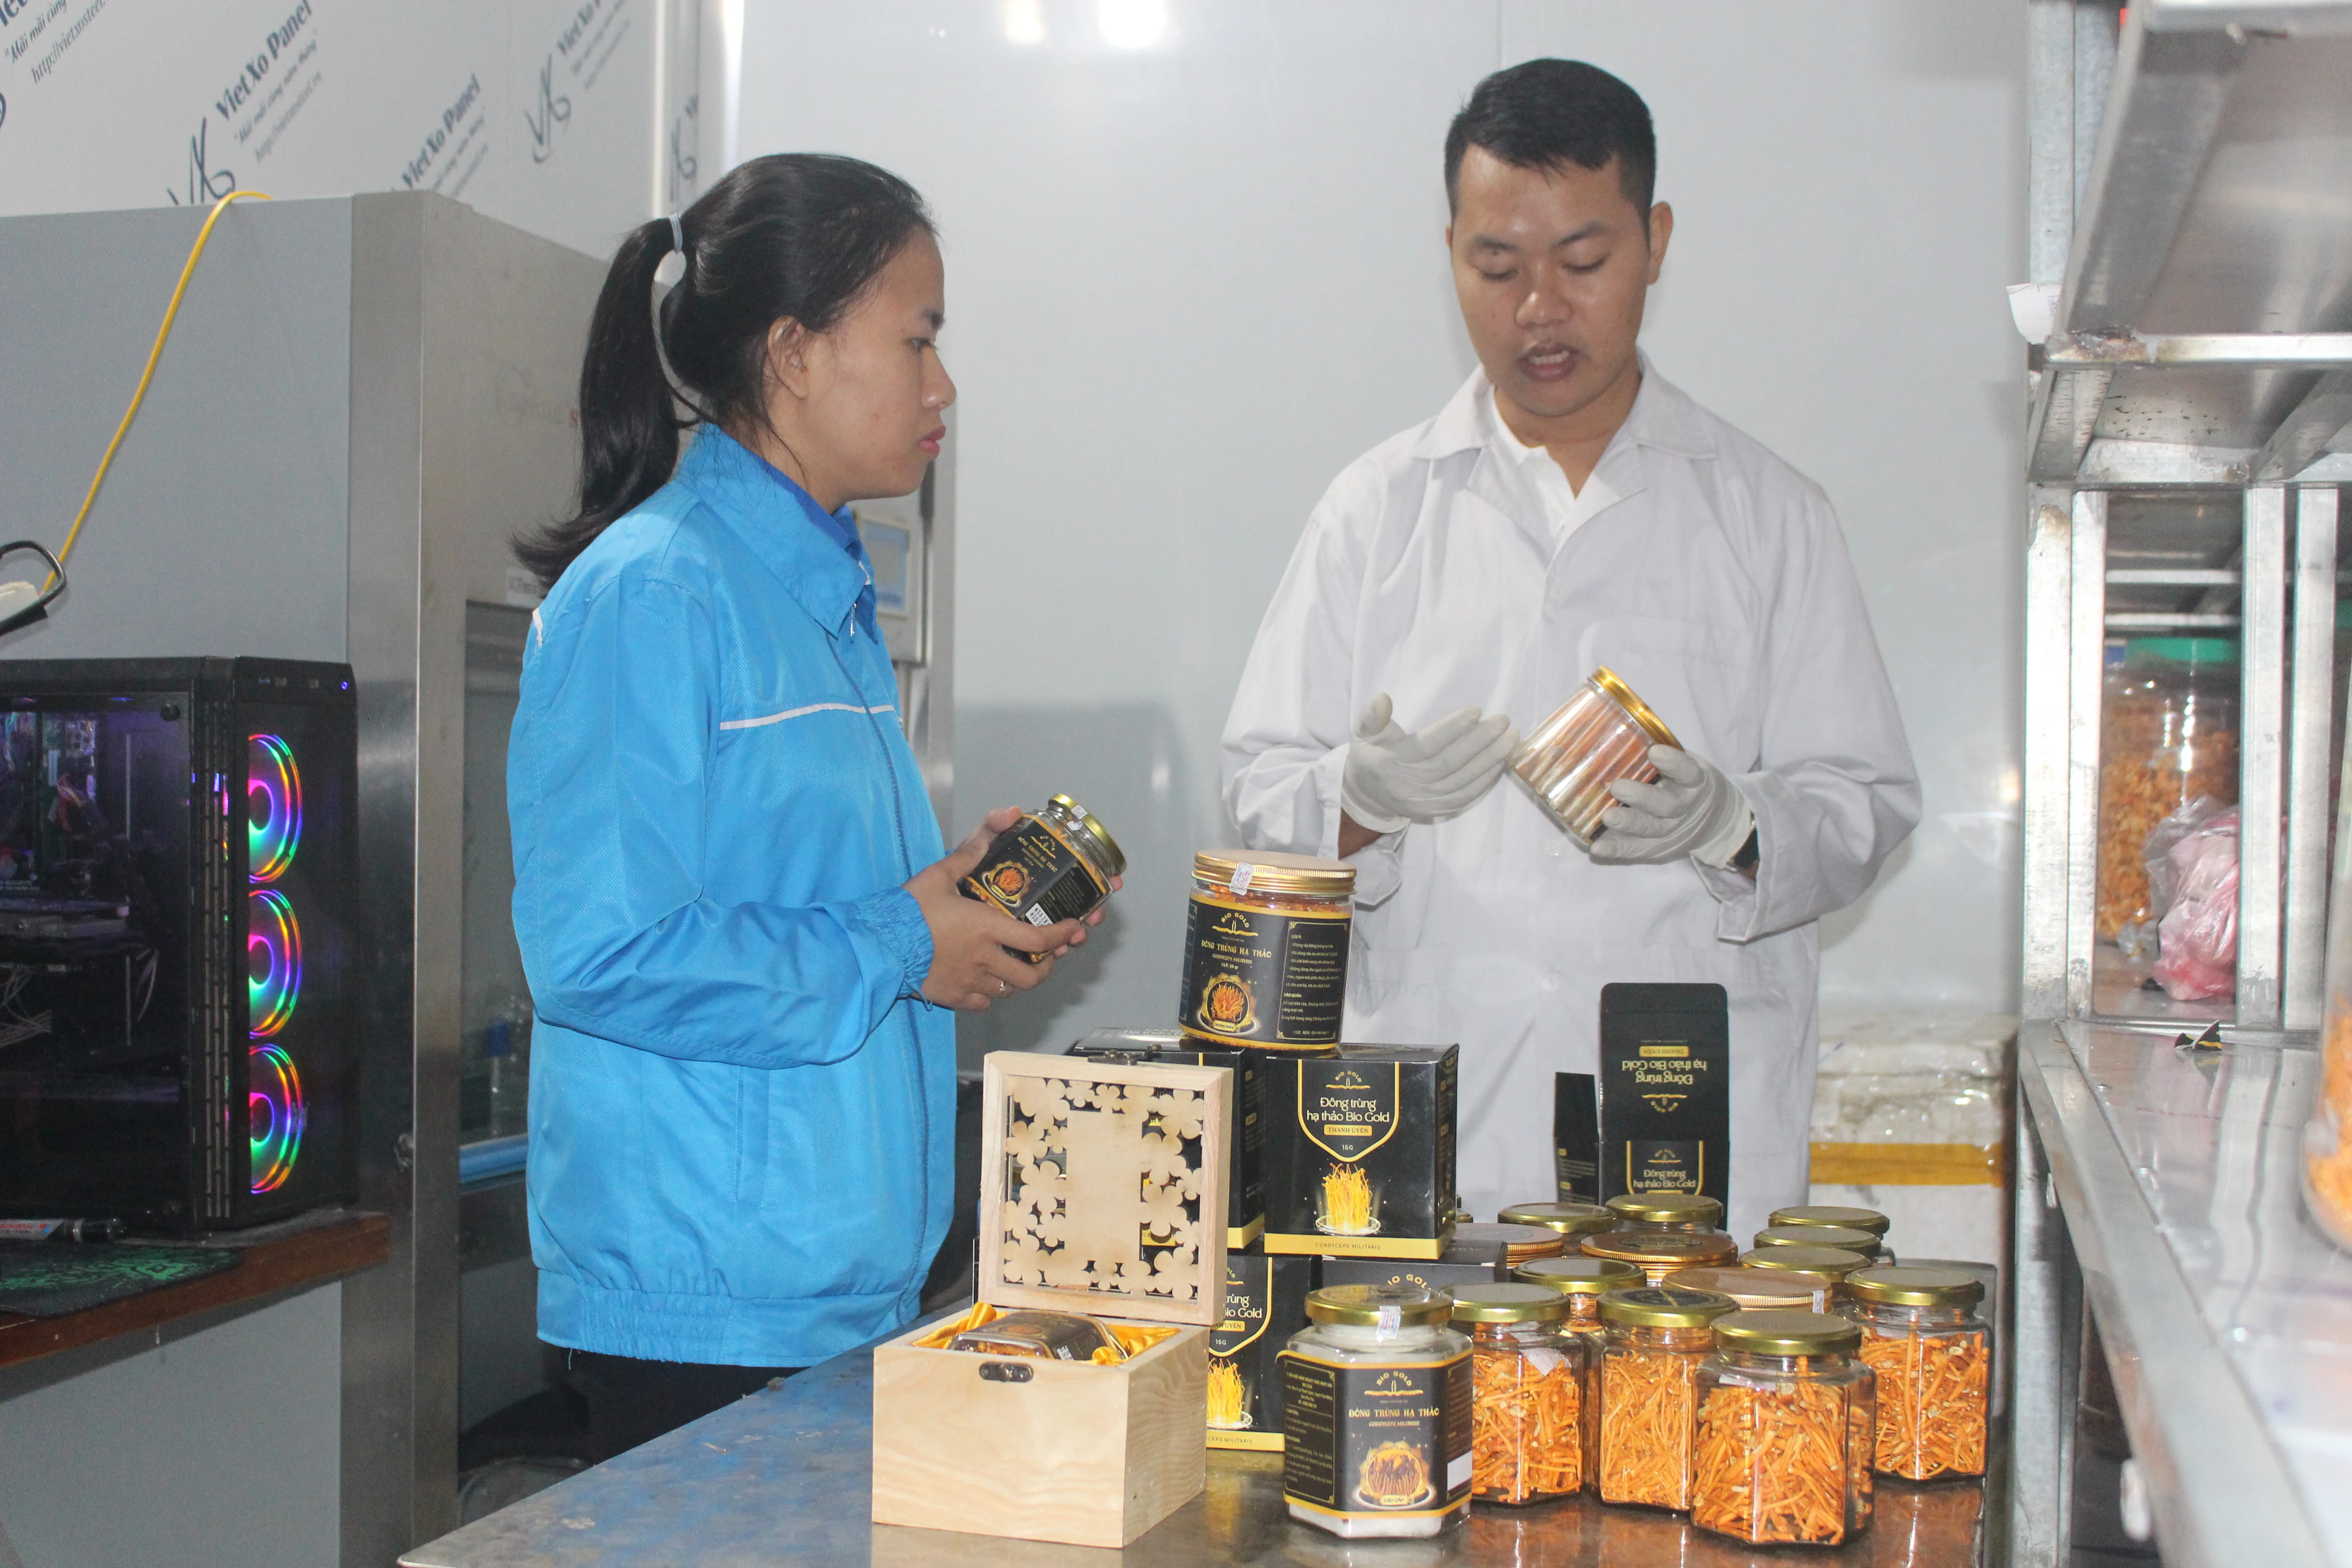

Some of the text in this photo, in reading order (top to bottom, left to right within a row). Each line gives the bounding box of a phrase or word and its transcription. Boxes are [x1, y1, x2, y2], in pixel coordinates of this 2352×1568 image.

[1034, 907, 1043, 918] NSX
[1221, 912, 1250, 928] BIO GOLD
[1212, 953, 1232, 961] CORDYCEPS
[1252, 948, 1272, 958] THẢO
[1622, 1059, 1707, 1071] hạ thảo Bio Gold
[1335, 1070, 1362, 1083] BIO GOLD
[1635, 1071, 1694, 1084] Đông trùng
[1320, 1097, 1377, 1112] Đông trùng
[1307, 1110, 1390, 1122] hạ thảo Bio Gold
[1643, 1169, 1666, 1180] Đông
[1676, 1179, 1696, 1188] Gold
[1226, 1267, 1235, 1278] OLD
[1406, 1273, 1431, 1290] GOL
[1226, 1293, 1250, 1308] rùng
[1225, 1307, 1262, 1318] io Gold
[1376, 1370, 1412, 1387] BIO GOLD
[1373, 1407, 1400, 1417] TRÙNG
[1404, 1409, 1415, 1418] HẠ
[1418, 1406, 1440, 1417] THẢO
